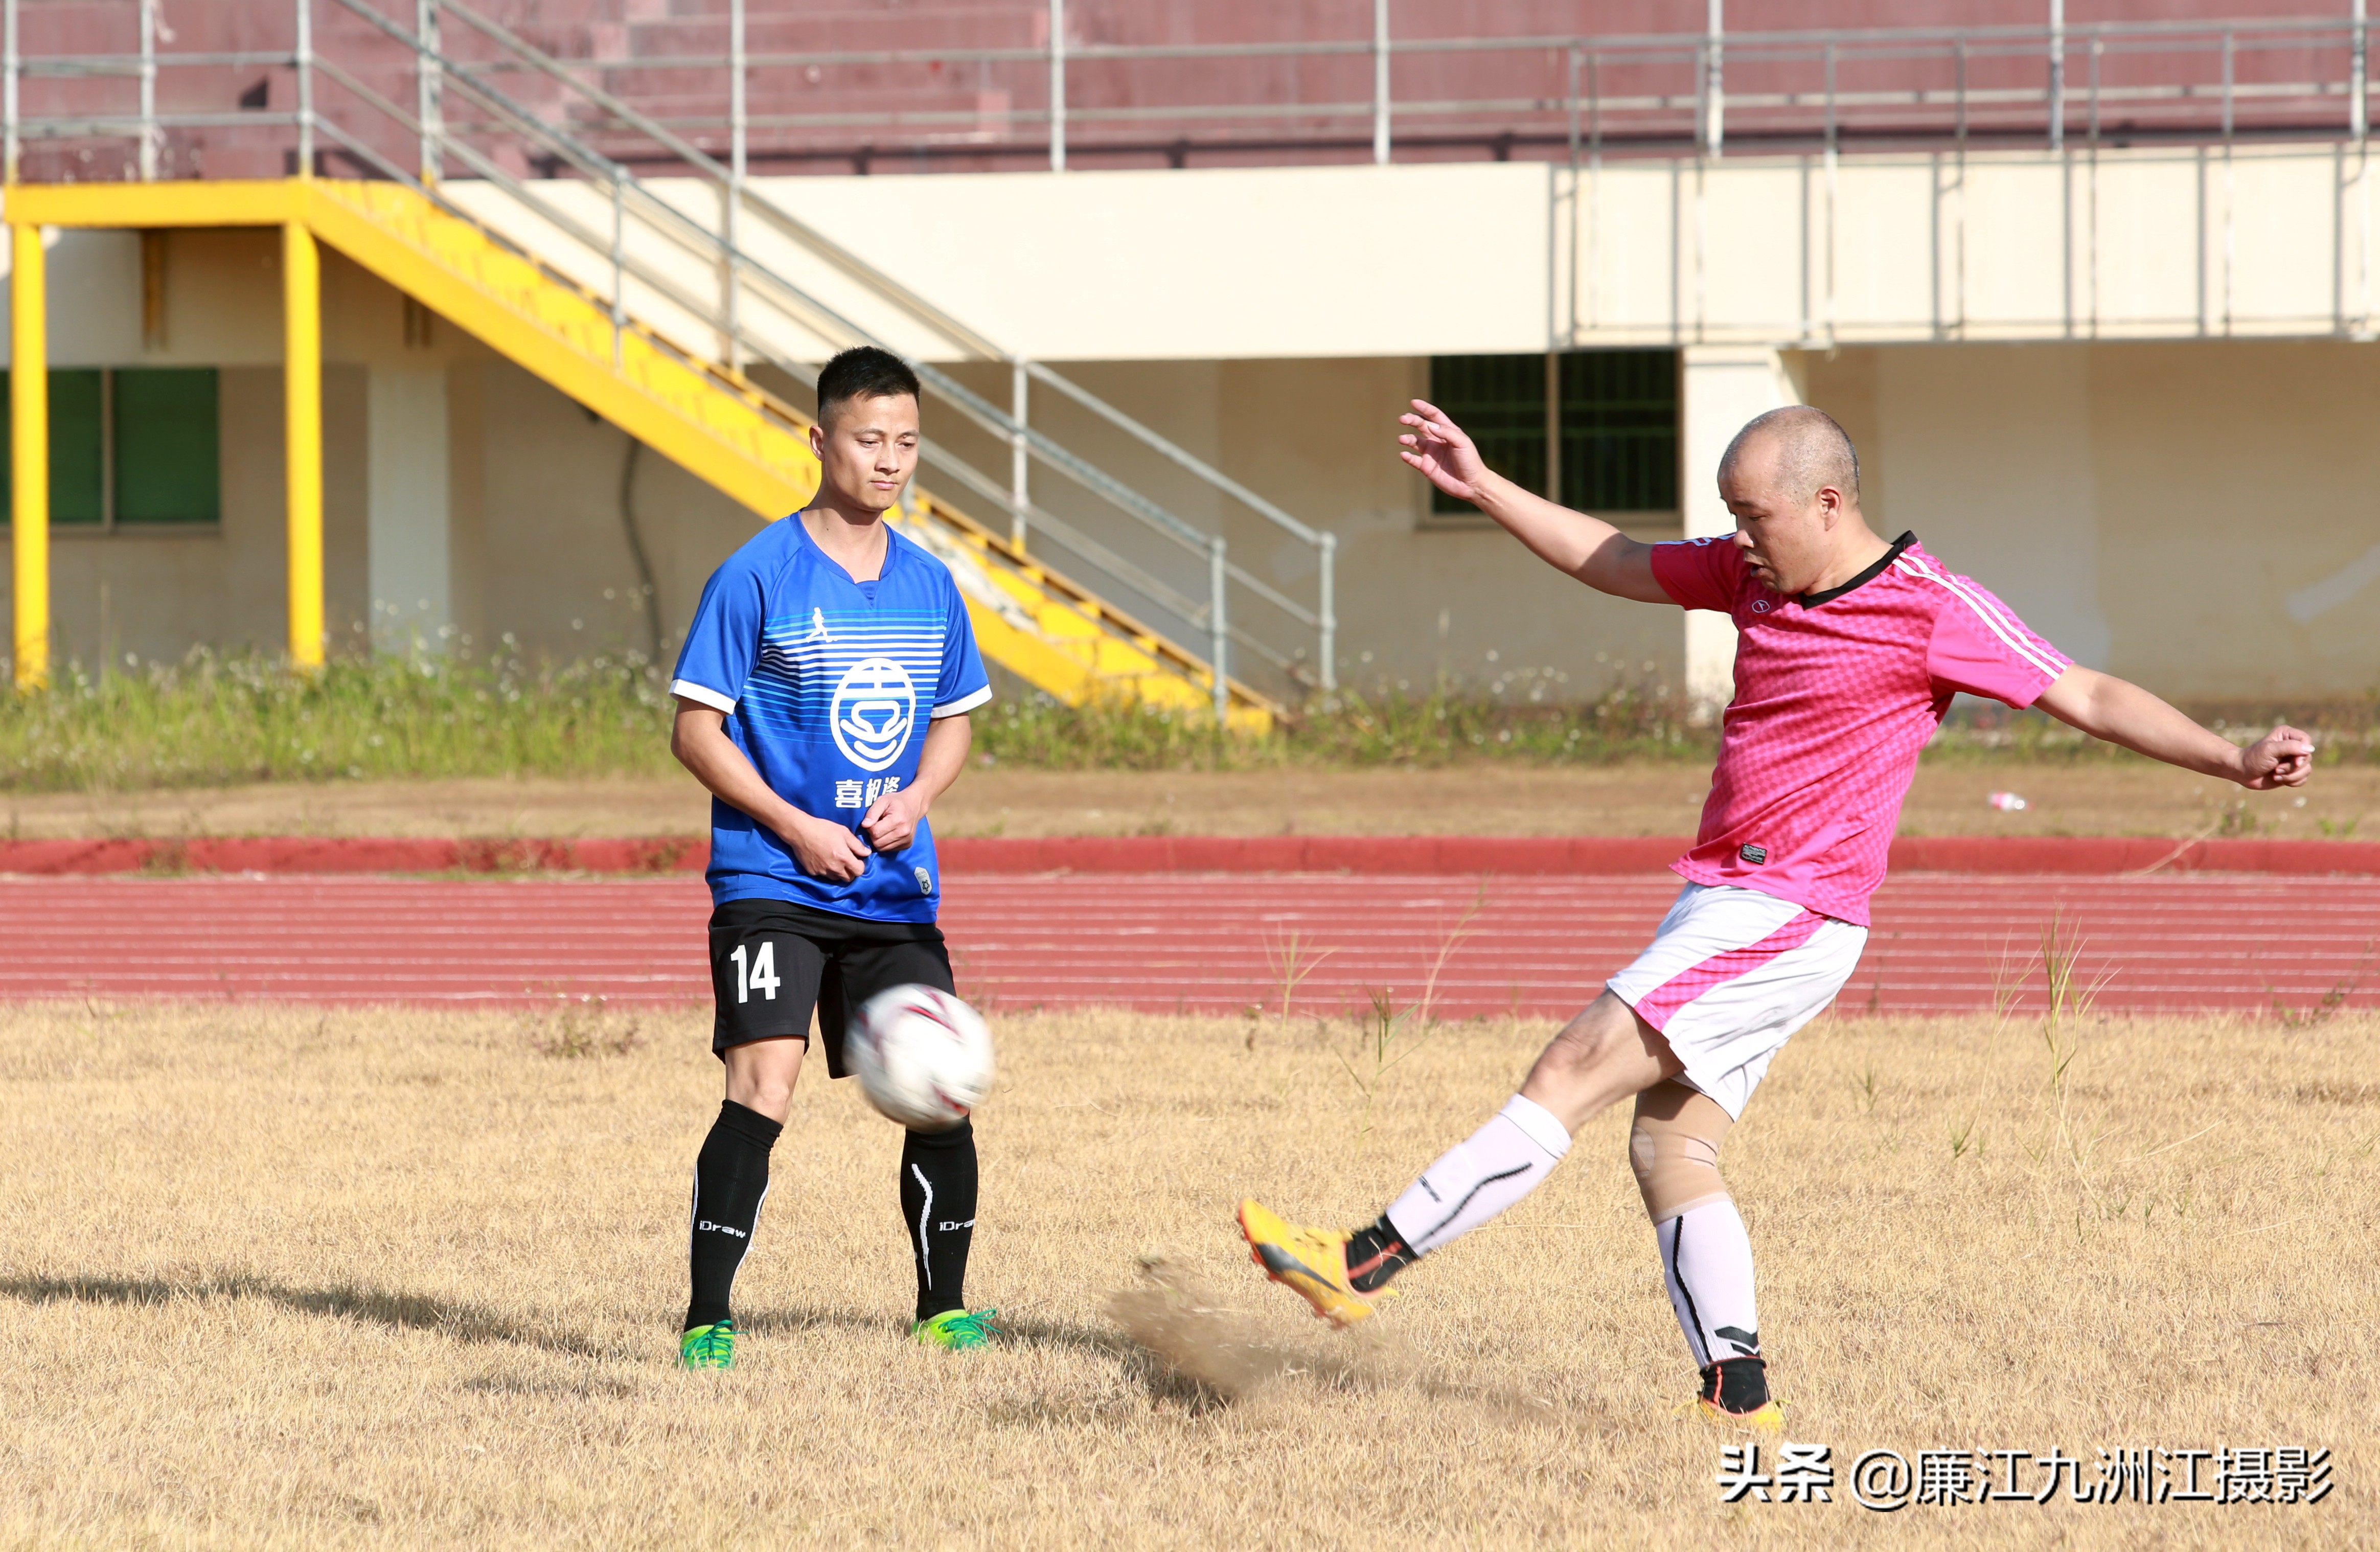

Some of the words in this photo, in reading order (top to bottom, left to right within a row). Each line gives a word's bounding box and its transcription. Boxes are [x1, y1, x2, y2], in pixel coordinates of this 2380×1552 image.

[730, 942, 781, 1003] 14
[699, 1220, 746, 1239] iDraw
[939, 1219, 975, 1231] iDra
